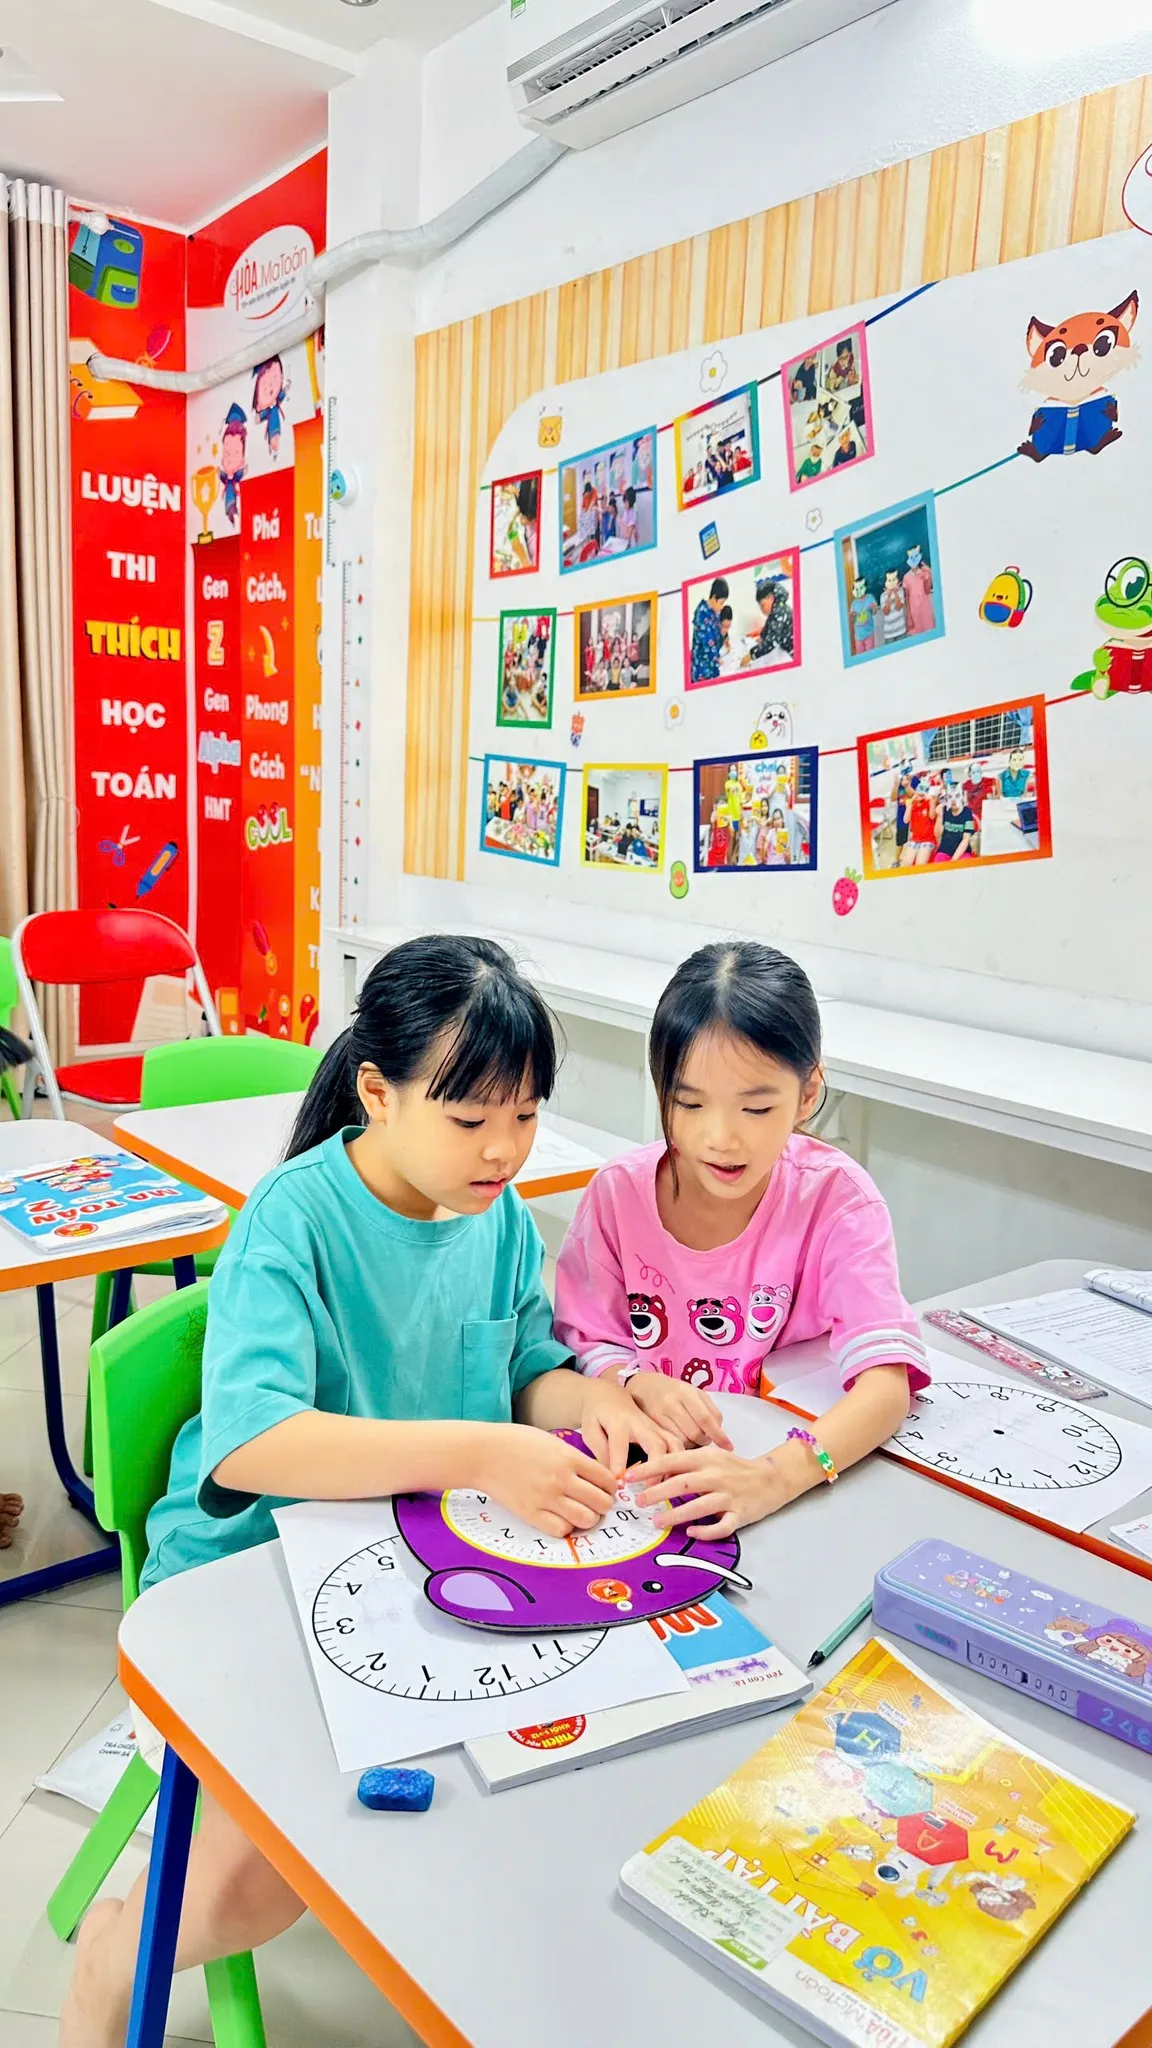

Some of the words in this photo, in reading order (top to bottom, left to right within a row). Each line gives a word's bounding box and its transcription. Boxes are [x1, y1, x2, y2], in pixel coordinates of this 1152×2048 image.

[81, 471, 181, 515] LUYỆN
[252, 508, 280, 541] Phá
[106, 551, 156, 583] THI
[202, 575, 228, 600] Gen
[246, 572, 287, 603] Cách,
[85, 615, 181, 661] THÍCH
[207, 620, 224, 665] Z
[204, 687, 229, 712] Gen
[101, 698, 166, 733] HỌC
[245, 694, 288, 725] Phong
[198, 731, 241, 774] Alpha
[250, 751, 285, 780] Cách
[91, 765, 177, 799] TOÁN
[204, 796, 232, 821] HMT
[246, 802, 292, 850] COOL
[126, 1189, 179, 1200] MA
[32, 1200, 120, 1225] TOÁN
[952, 1390, 971, 1400] 7
[990, 1391, 1009, 1401] 8
[1036, 1403, 1055, 1413] 9
[906, 1431, 924, 1440] 4
[1062, 1424, 1088, 1437] 10
[1077, 1441, 1103, 1454] 11
[937, 1452, 958, 1462] 3
[989, 1467, 1012, 1479] 2
[1033, 1469, 1052, 1479] 1
[1068, 1460, 1098, 1475] 12
[479, 1512, 492, 1523] 3
[615, 1509, 639, 1522] 10
[501, 1528, 515, 1539] 2
[600, 1526, 624, 1539] 11
[533, 1538, 548, 1550] 1
[572, 1535, 594, 1548] 12
[377, 1556, 395, 1571] 5
[344, 1582, 362, 1596] 4
[336, 1617, 355, 1634] 3
[532, 1640, 568, 1660] 11
[365, 1652, 387, 1671] 2
[421, 1665, 436, 1683] 1
[473, 1664, 517, 1686] 12
[749, 1674, 765, 1684] Con
[766, 1669, 784, 1680] Tên
[541, 1732, 574, 1748] THÍCH
[853, 1946, 928, 2004] VỞ
